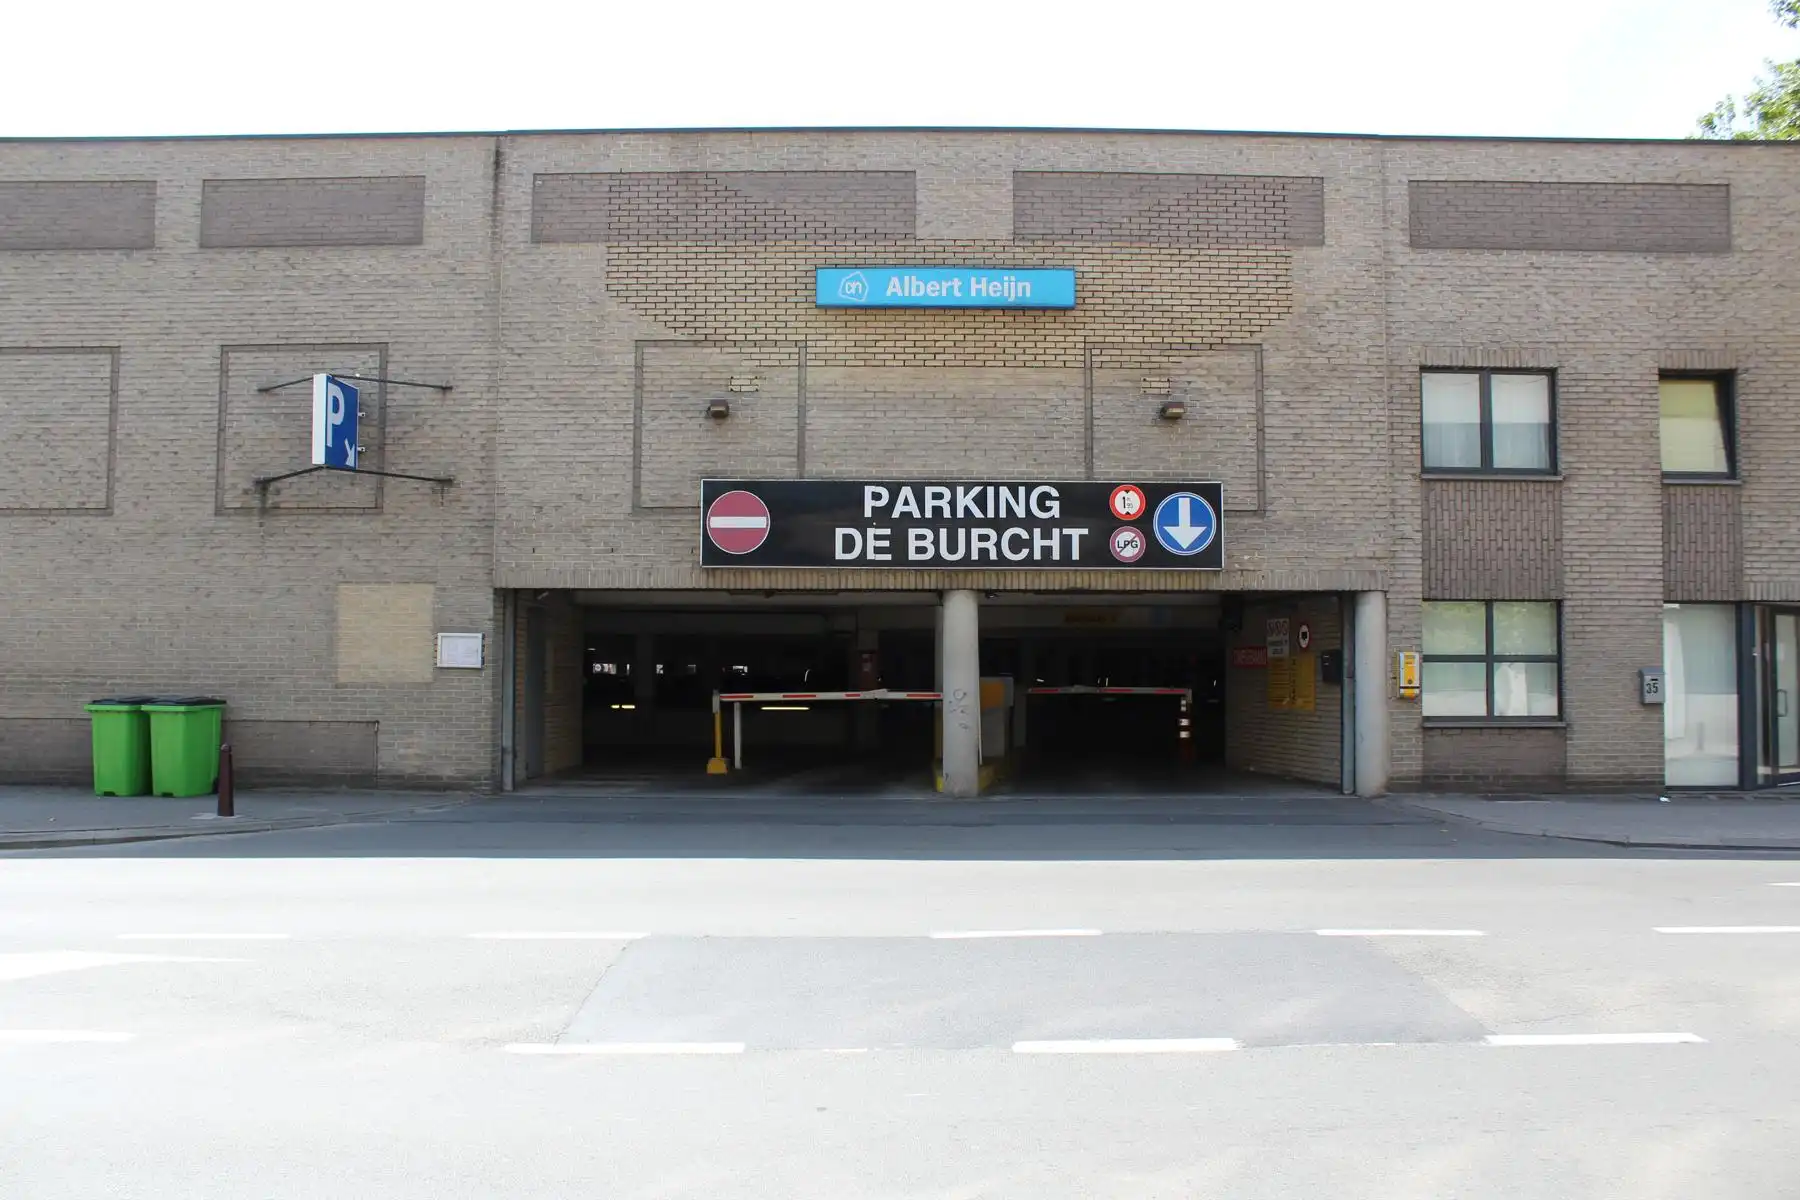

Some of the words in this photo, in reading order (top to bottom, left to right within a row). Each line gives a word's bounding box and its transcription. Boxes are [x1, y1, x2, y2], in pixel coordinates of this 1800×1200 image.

[886, 276, 962, 297] Albert
[970, 276, 1031, 301] Heijn
[327, 381, 345, 448] P
[863, 485, 1060, 519] PARKING
[835, 527, 892, 561] DE
[908, 527, 1088, 561] BURCHT
[1117, 540, 1138, 549] LPG
[1646, 682, 1658, 694] 35
